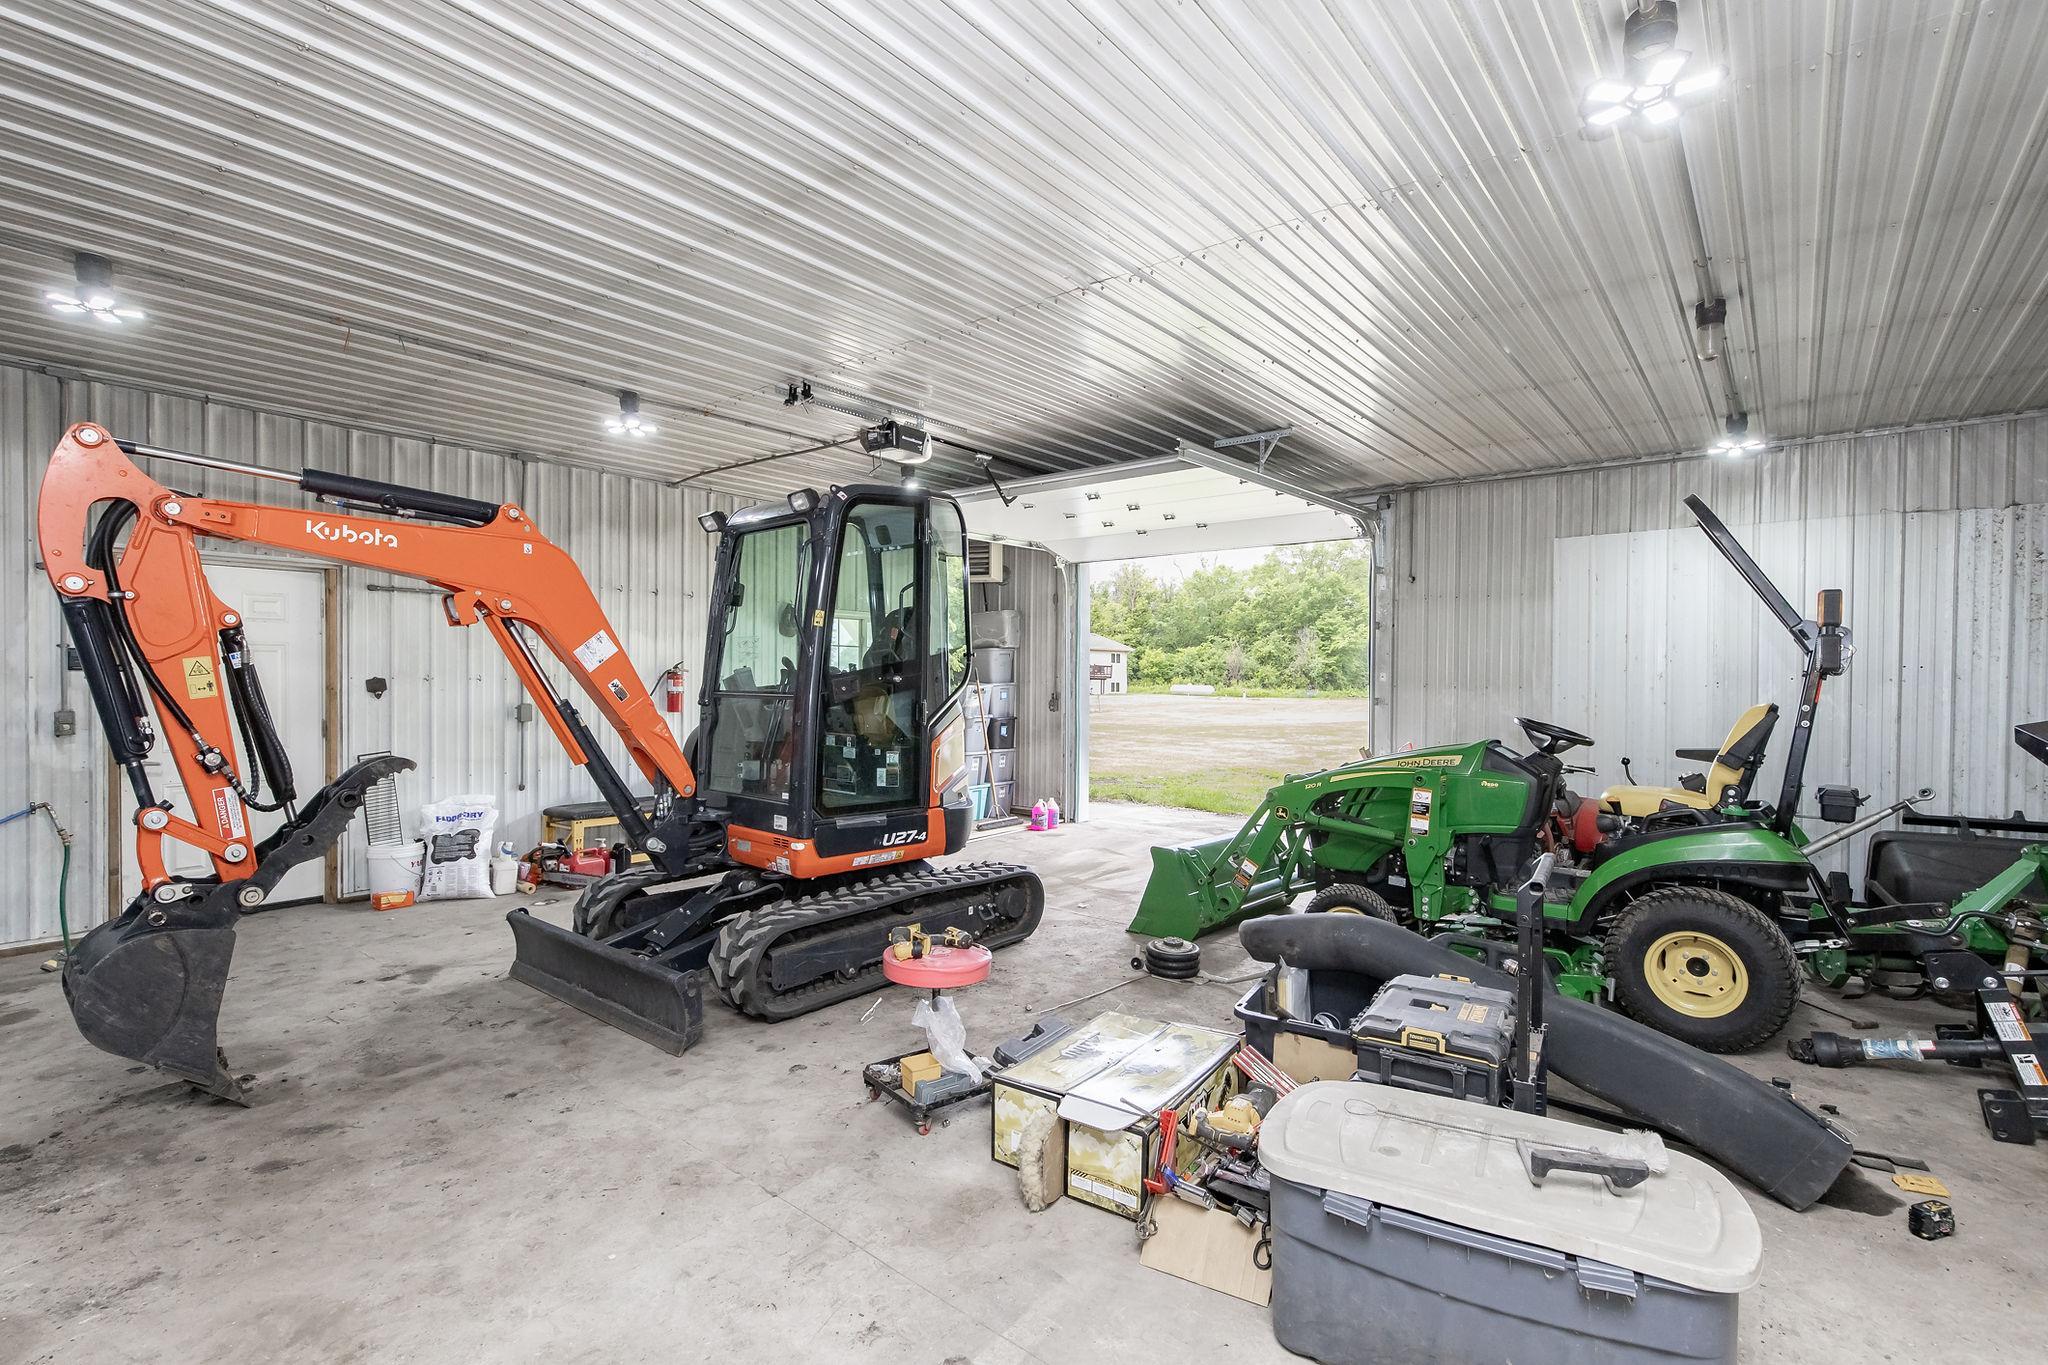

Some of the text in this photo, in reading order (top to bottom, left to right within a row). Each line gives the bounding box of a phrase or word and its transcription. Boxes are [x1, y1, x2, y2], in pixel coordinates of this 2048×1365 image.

[306, 519, 398, 548] Kubota
[1397, 757, 1456, 767] JOHN DEERE
[216, 796, 229, 824] DANGER
[882, 829, 927, 847] U27-4
